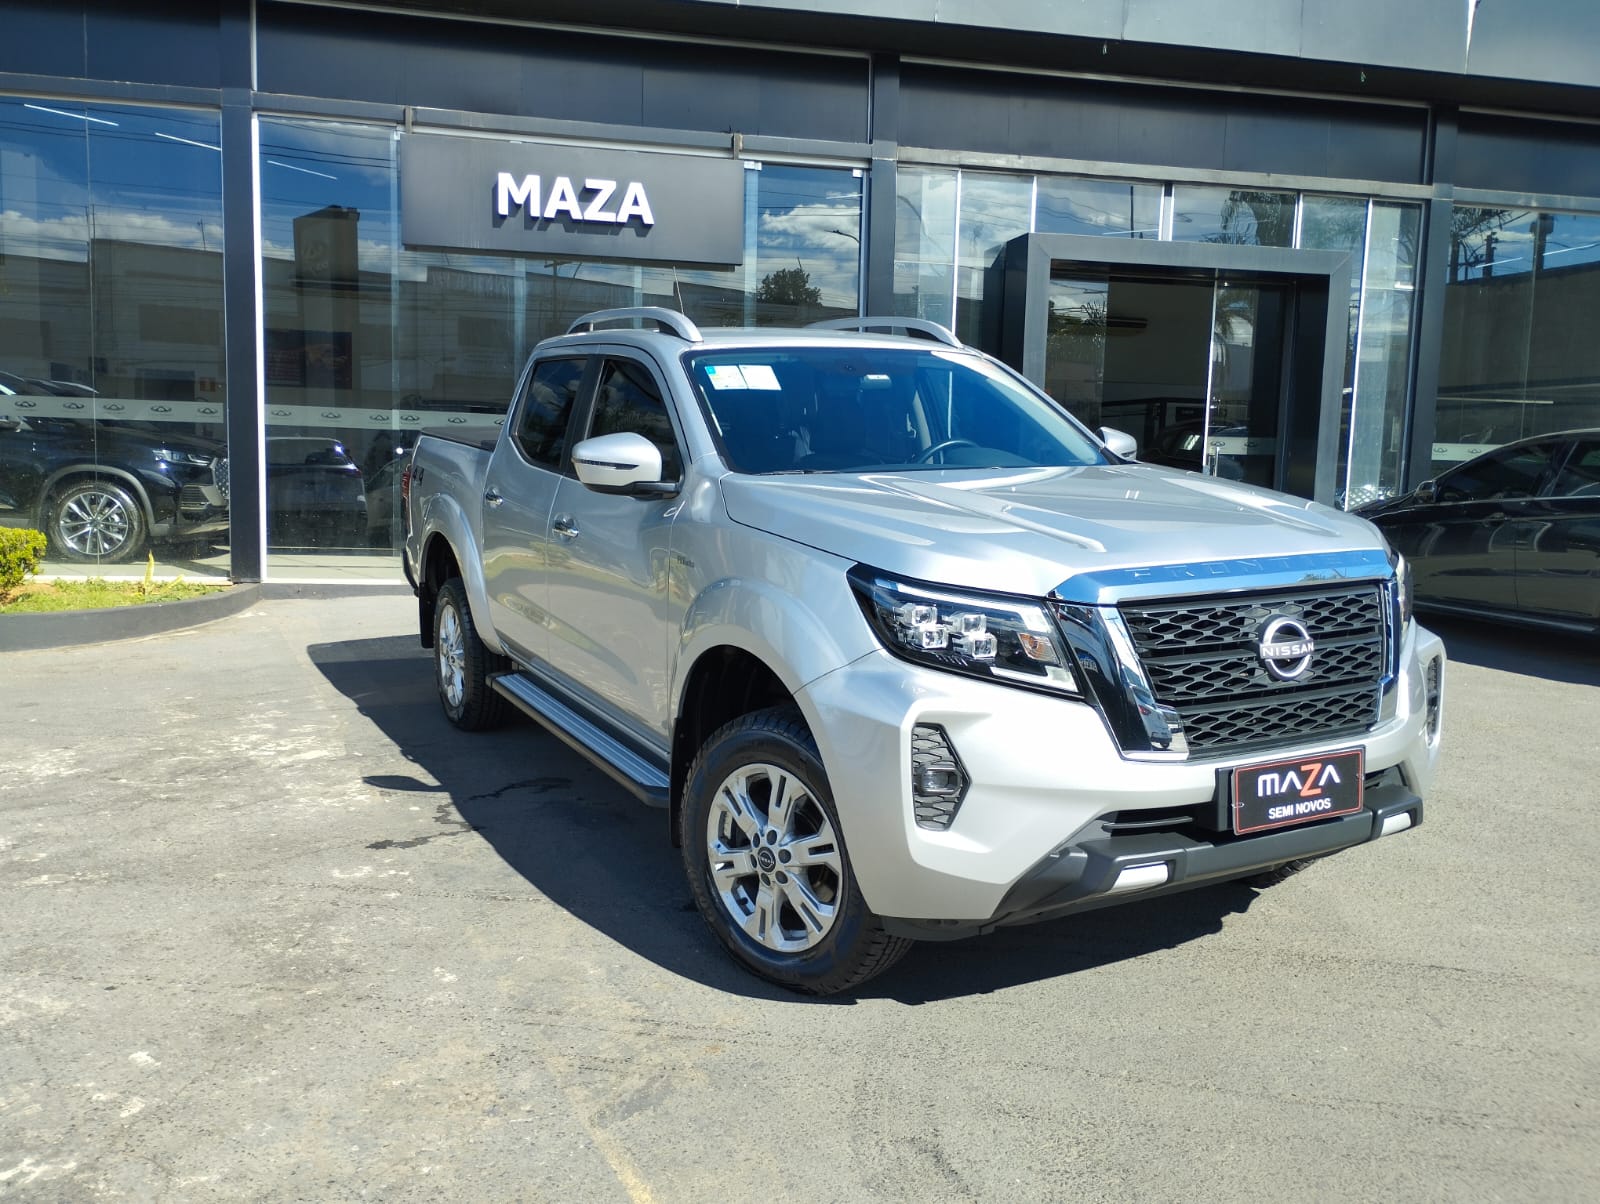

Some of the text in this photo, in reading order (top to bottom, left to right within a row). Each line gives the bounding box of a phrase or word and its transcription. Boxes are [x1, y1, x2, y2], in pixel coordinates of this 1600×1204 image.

[497, 172, 655, 225] MAZA
[1124, 552, 1371, 579] FRONTE
[1262, 642, 1314, 657] NISSAN
[1257, 762, 1341, 798] MAZA
[1268, 797, 1331, 820] SEMI NOVOS
